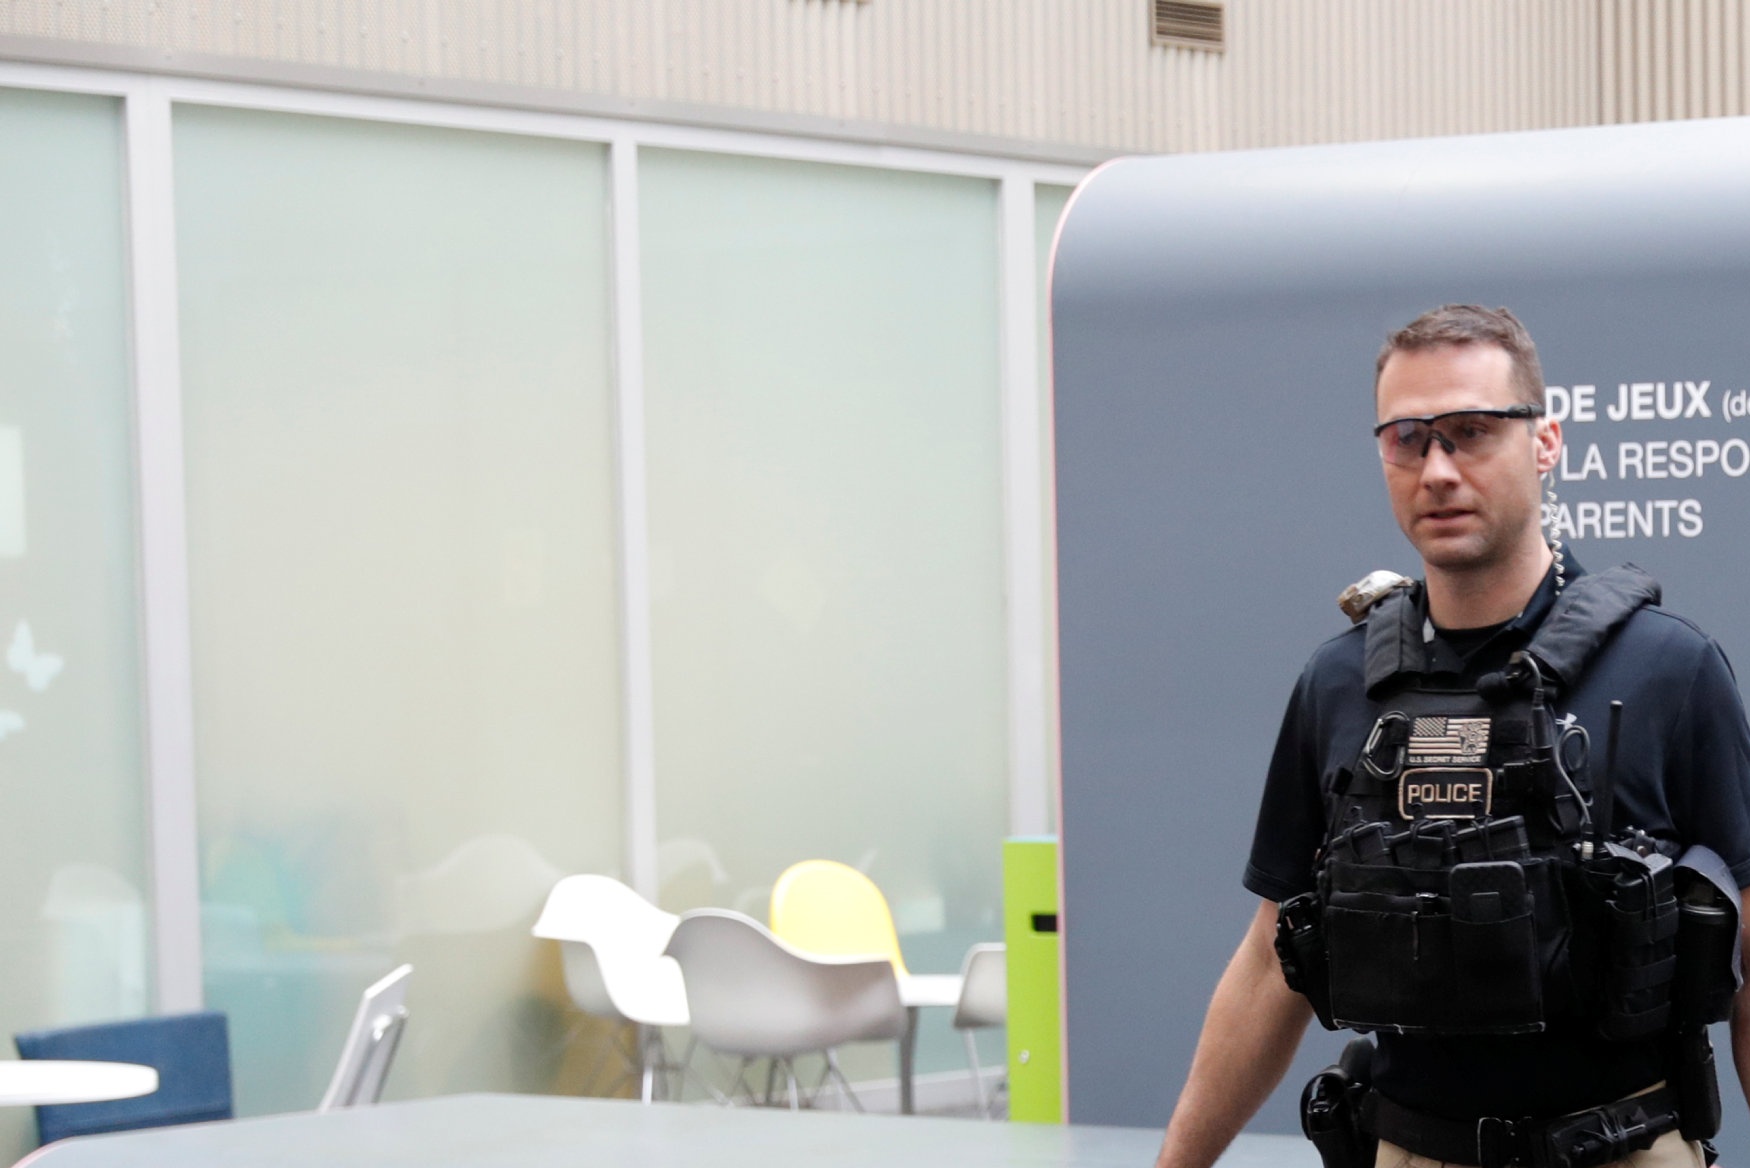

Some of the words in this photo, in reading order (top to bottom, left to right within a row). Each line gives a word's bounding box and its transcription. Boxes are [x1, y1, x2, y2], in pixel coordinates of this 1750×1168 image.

[1545, 385, 1597, 423] DE
[1607, 380, 1712, 421] JEUX
[1561, 444, 1607, 481] LA
[1407, 783, 1482, 804] POLICE
